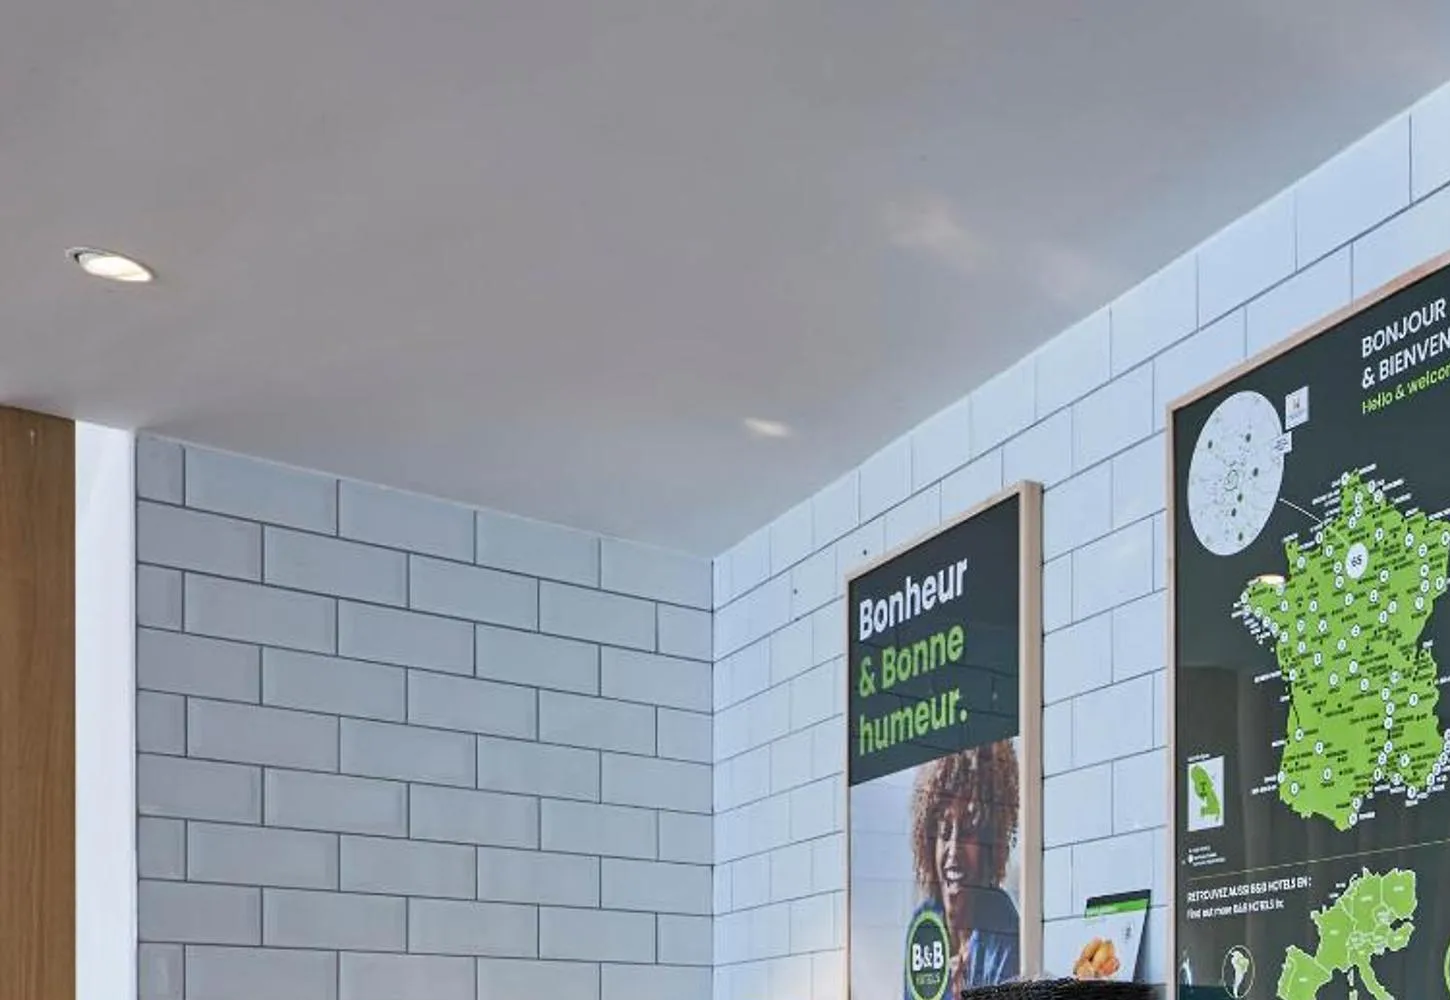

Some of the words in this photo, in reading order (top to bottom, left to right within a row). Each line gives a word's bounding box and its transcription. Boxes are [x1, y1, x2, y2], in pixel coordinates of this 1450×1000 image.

[1362, 298, 1446, 358] BONJOUR
[1361, 366, 1375, 389] &
[1362, 392, 1393, 415] Hello
[1395, 384, 1405, 400] &
[859, 558, 967, 641] Bonheur
[860, 656, 875, 697] &
[882, 625, 965, 689] Bonne
[860, 688, 968, 756] humeur.
[912, 941, 944, 971] B&B
